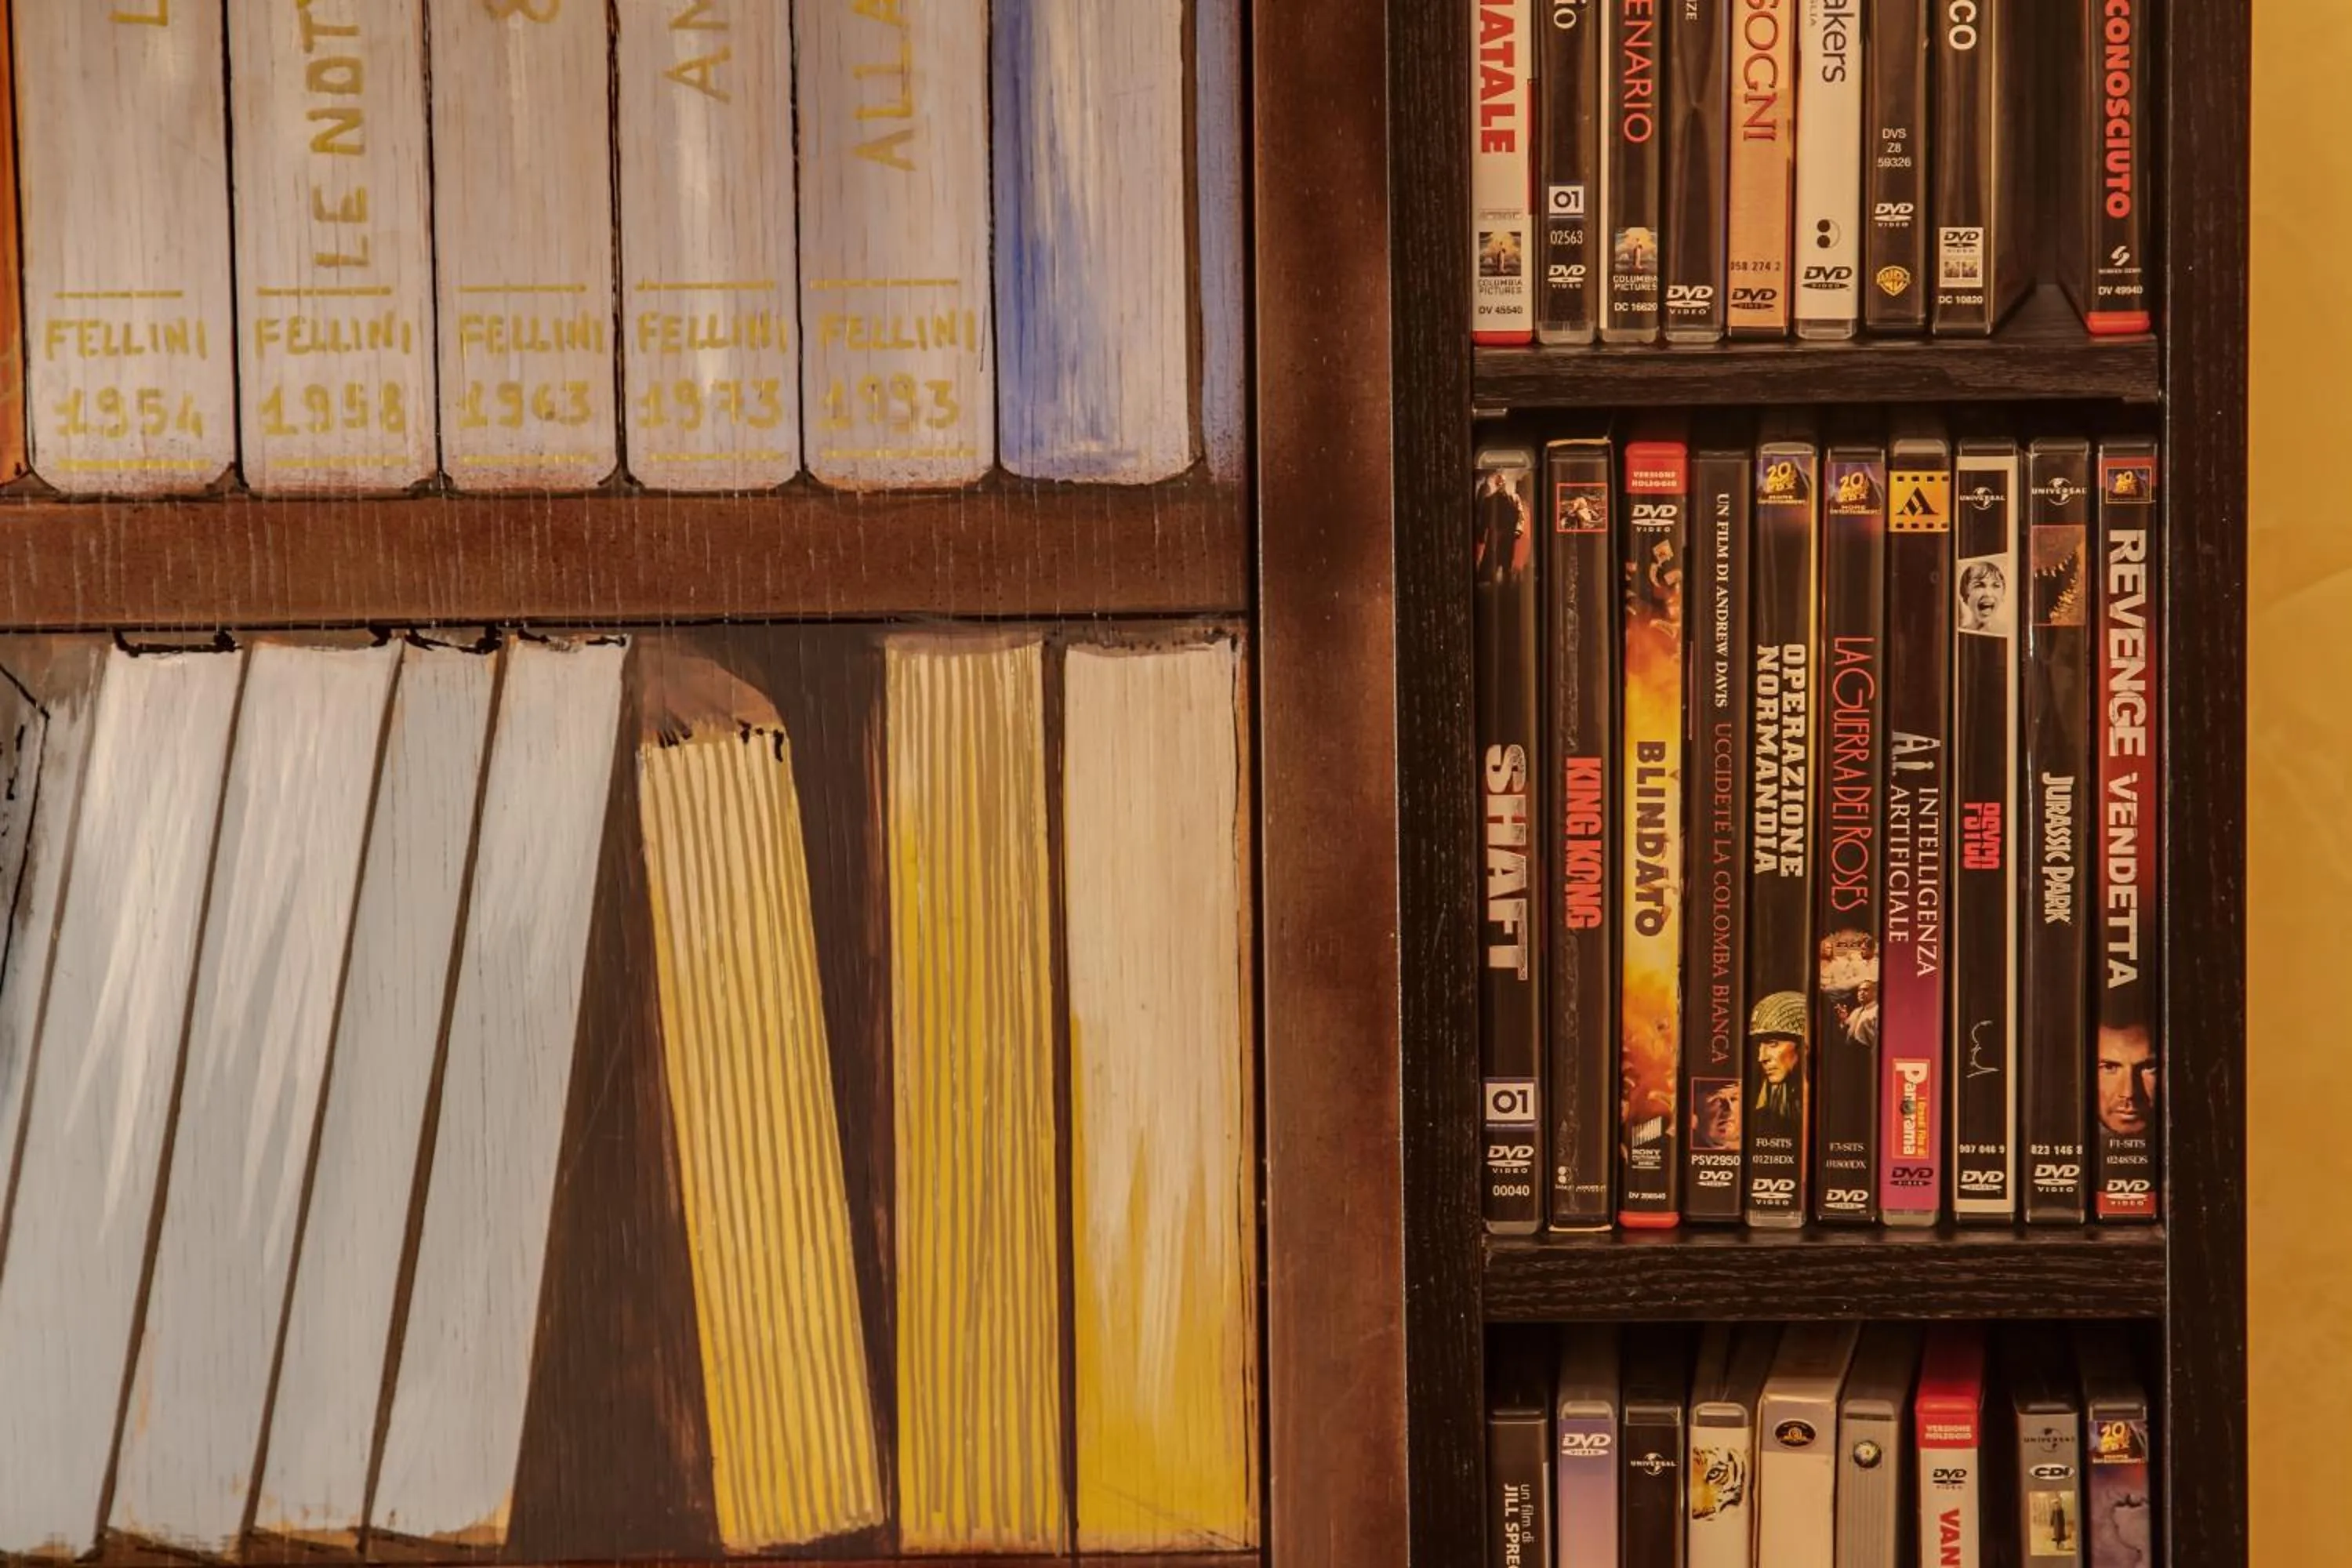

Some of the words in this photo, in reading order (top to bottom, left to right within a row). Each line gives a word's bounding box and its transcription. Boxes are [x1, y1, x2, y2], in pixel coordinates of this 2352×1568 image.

[296, 0, 366, 156] NOT
[1479, 0, 1516, 154] ATALE
[1624, 0, 1653, 143] ENARIO
[2105, 0, 2131, 218] CONOSCIUTO
[1882, 128, 1907, 140] DVS
[314, 186, 369, 268] LE
[1874, 202, 1915, 215] DVD
[1550, 230, 1583, 245] 02563
[1944, 231, 1980, 241] DVD
[1548, 264, 1587, 277] DVD
[1802, 266, 1853, 281] DVD
[1614, 302, 1628, 311] DC
[1667, 285, 1714, 301] DVD
[1731, 288, 1777, 301] DVD
[45, 317, 209, 360] FELLINI
[255, 310, 412, 358] FELLINI
[459, 310, 606, 358] FELLINI
[637, 309, 789, 354] FELLINI
[818, 309, 978, 353] FELLINI
[53, 385, 204, 439] 1954
[259, 380, 408, 436] 1958
[457, 380, 593, 429] 1963
[637, 378, 783, 431] 1973
[1632, 504, 1678, 519] DVD
[1717, 492, 1730, 516] UN
[2031, 487, 2087, 495] UNIVERSAL
[1716, 521, 1730, 558] FILM
[1716, 563, 1729, 583] DI
[1715, 586, 1730, 657] ANDREW
[2107, 529, 2147, 757] REVENGE
[1714, 661, 1729, 709] DAVIS
[1831, 666, 1875, 782] GUERRA
[1713, 723, 1732, 832] UCCIDETE
[1754, 645, 1780, 875] NORMANDIA
[1780, 643, 1806, 877] OPERAZIONE
[1565, 757, 1602, 836] KING
[1831, 786, 1872, 821] DEI
[2042, 771, 2075, 863] JURASSIC
[1635, 741, 1668, 937] BLINDATO
[1712, 836, 1731, 863] LA
[1485, 743, 1529, 981] SHAFT
[1830, 826, 1874, 913] ROSES
[1889, 785, 1911, 944] ARTIFICIALE
[1916, 787, 1940, 978] INTELLIGENZA
[2107, 771, 2139, 989] VENDETTA
[1565, 840, 1602, 931] KONG
[2042, 865, 2075, 925] PARK
[1712, 869, 1731, 978] COLOMBA
[1711, 985, 1730, 1063] BIANCA
[1488, 1145, 1534, 1161] DVD
[1892, 1167, 1934, 1180] DVD
[2034, 1164, 2080, 1178] DVD
[1492, 1185, 1530, 1196] 00040
[1698, 1171, 1733, 1181] DVD
[1752, 1178, 1796, 1192] DVD
[1826, 1189, 1869, 1203] DVD
[1961, 1171, 2005, 1185] DVD
[2107, 1179, 2151, 1194] DVD
[1563, 1433, 1611, 1449] DVD
[1520, 1484, 1530, 1500] un
[1933, 1468, 1967, 1479] DVD
[1504, 1483, 1519, 1517] JILL
[1520, 1504, 1534, 1528] film
[1504, 1523, 1521, 1568] SPRE
[1522, 1531, 1535, 1543] di
